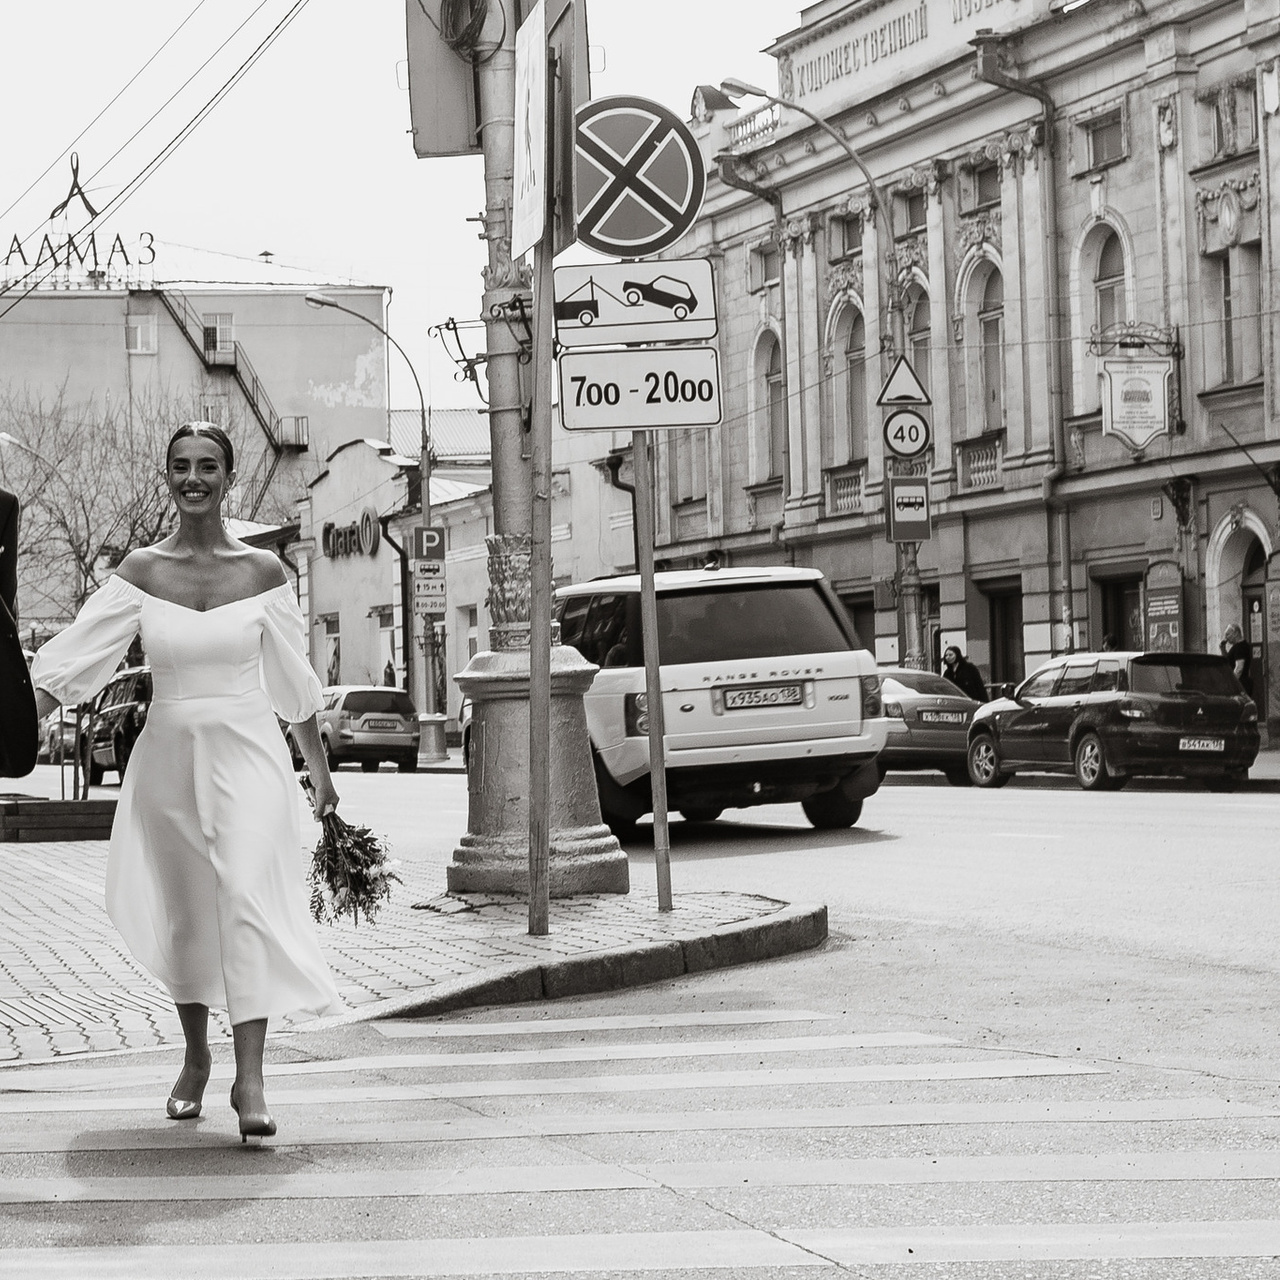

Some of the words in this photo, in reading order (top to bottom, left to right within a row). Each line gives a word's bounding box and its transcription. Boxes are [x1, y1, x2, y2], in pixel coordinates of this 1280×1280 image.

[797, 0, 928, 97] ХУДОЖЕСТВЕННЫЙ
[893, 425, 920, 443] 40
[422, 531, 440, 556] P
[702, 672, 758, 682] RANGE
[769, 667, 824, 676] ROVER
